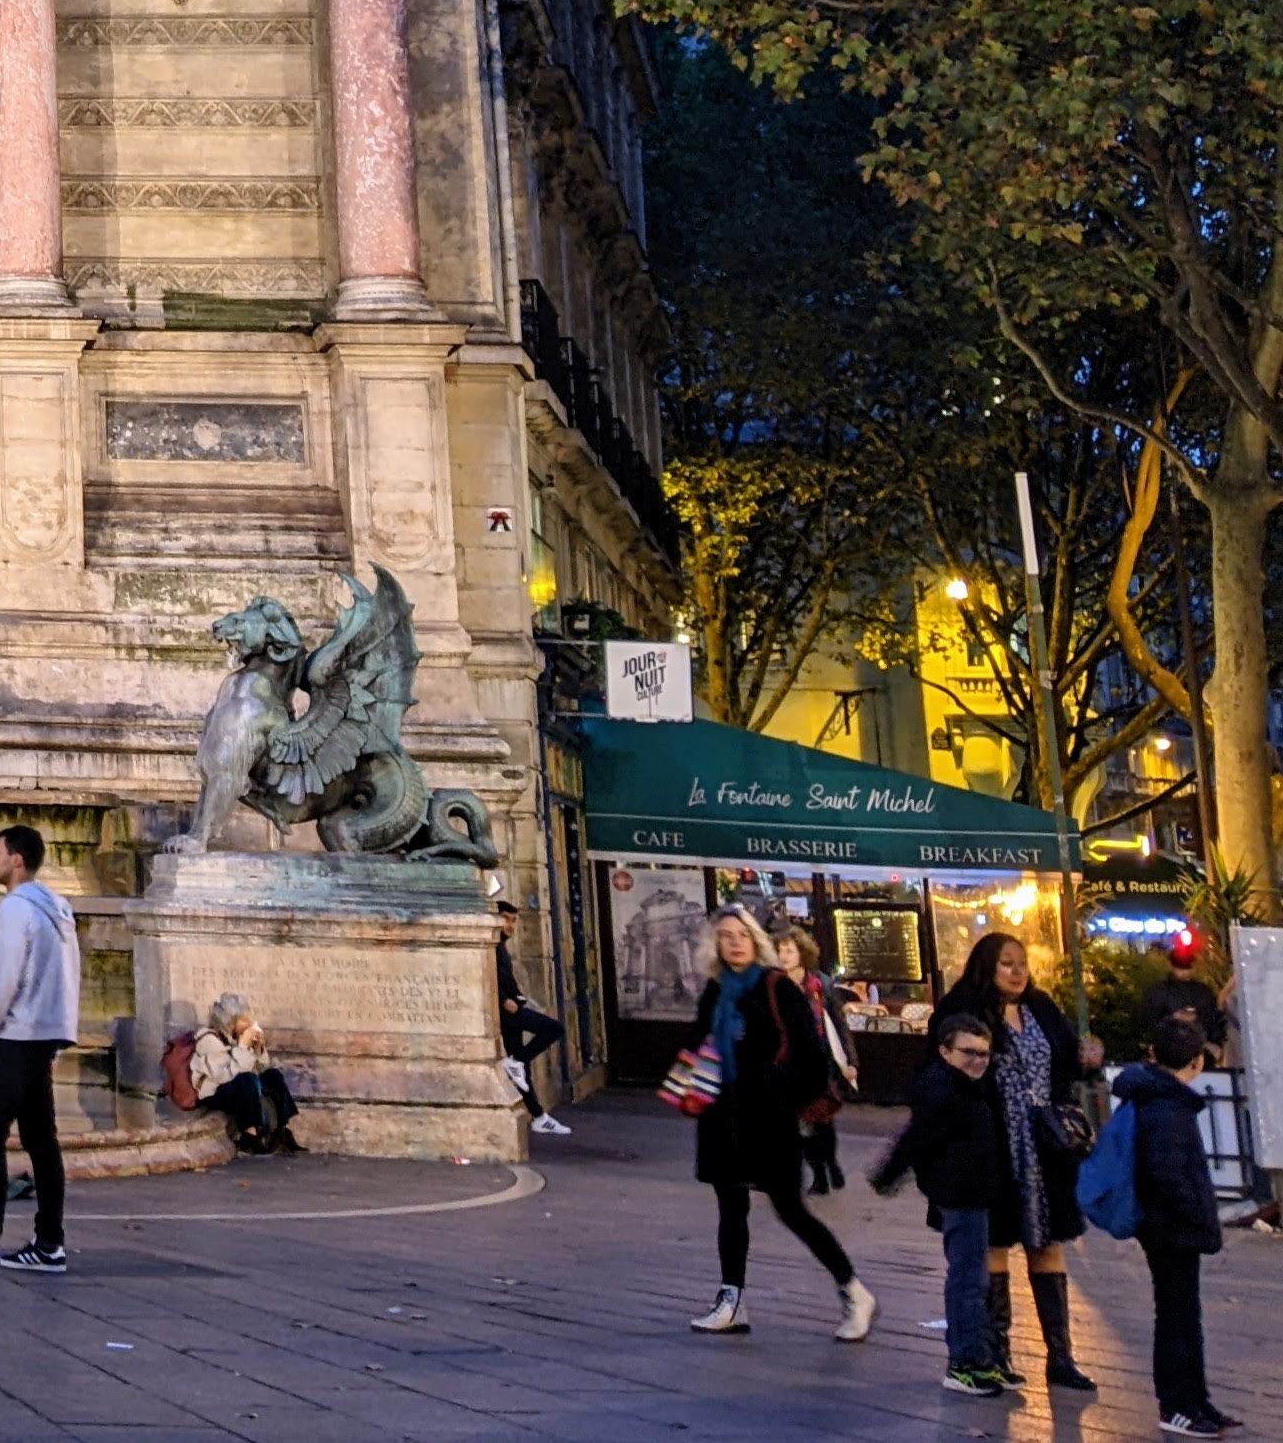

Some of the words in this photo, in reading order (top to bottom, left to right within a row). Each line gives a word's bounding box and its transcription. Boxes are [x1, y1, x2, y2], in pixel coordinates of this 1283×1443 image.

[622, 650, 656, 678] JOUR
[634, 664, 667, 692] NUIT
[688, 777, 707, 807] La
[717, 781, 794, 807] Fontaine
[806, 783, 862, 810] Saint
[866, 785, 937, 814] Michel
[633, 830, 685, 848] CAFE
[747, 837, 858, 857] BRASSERIE
[919, 844, 1042, 865] BREAKFAST
[1116, 880, 1126, 892] &
